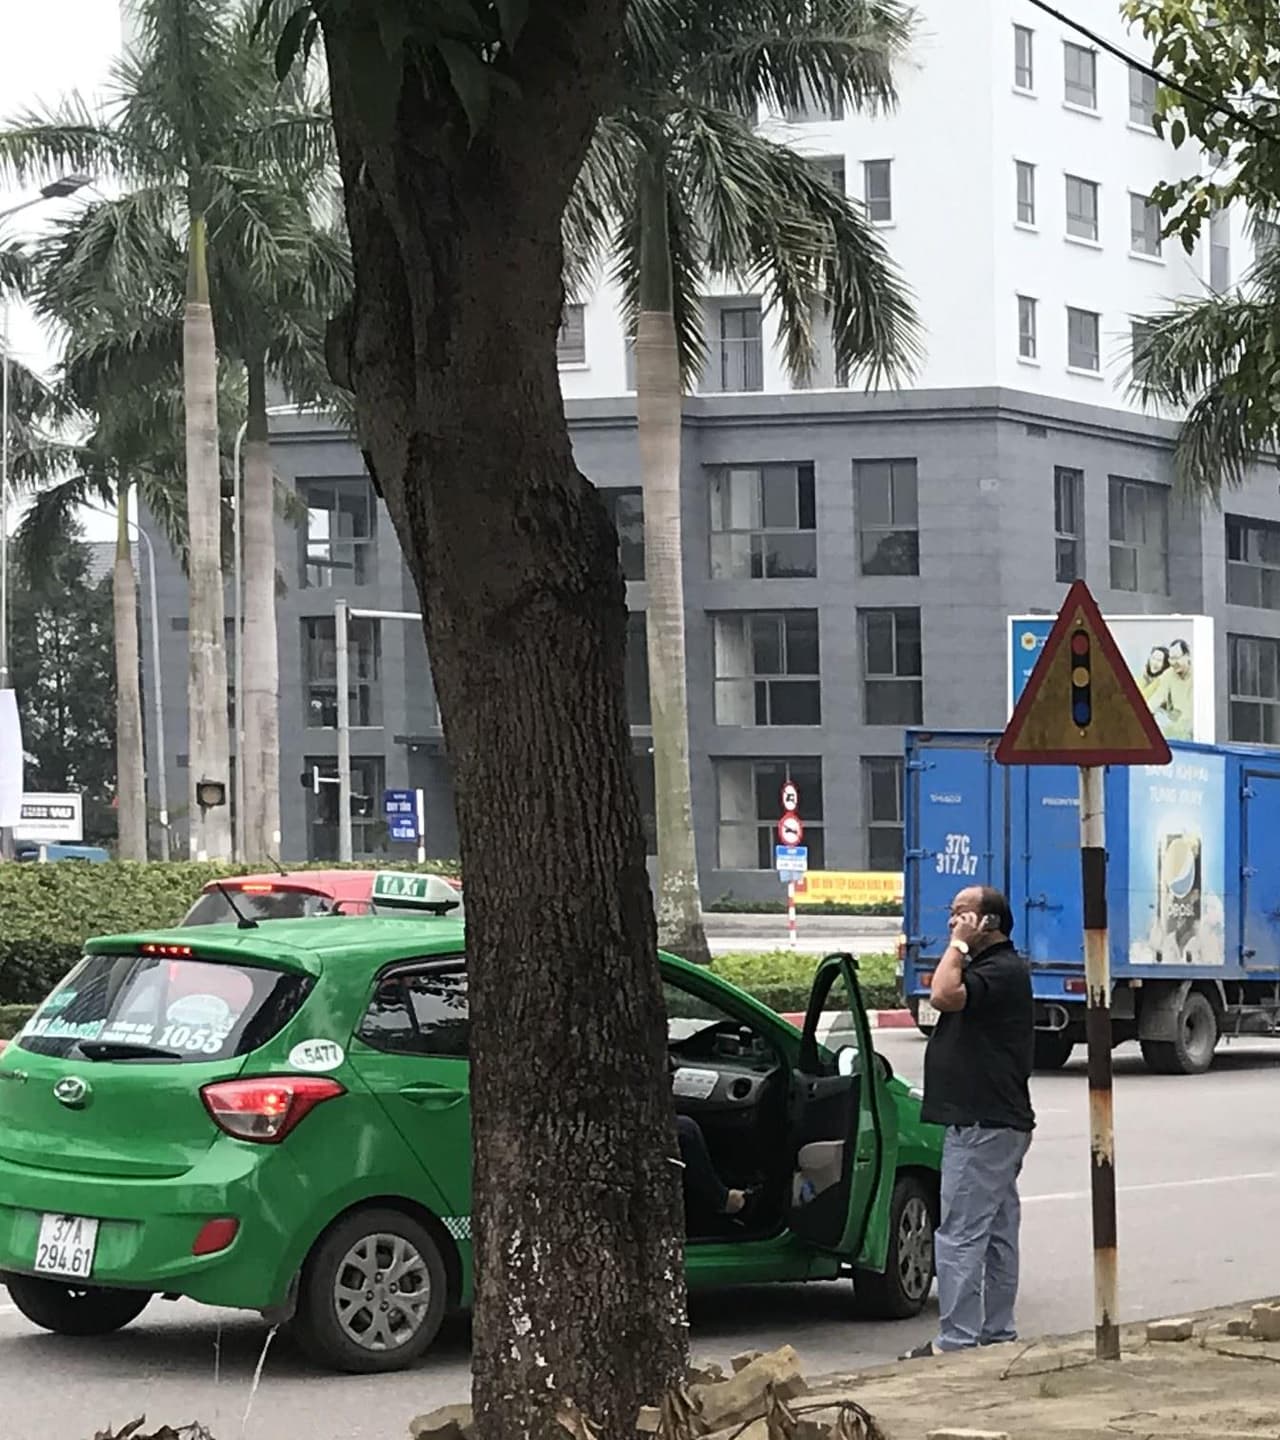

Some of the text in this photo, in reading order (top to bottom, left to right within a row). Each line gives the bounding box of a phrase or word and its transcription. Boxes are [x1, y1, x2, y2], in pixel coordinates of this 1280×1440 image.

[945, 834, 970, 854] 37C
[936, 853, 978, 876] 317.47
[157, 1025, 228, 1053] 1055
[304, 1044, 338, 1063] 5477
[53, 1217, 82, 1244] 37A
[38, 1243, 90, 1274] 294.61
